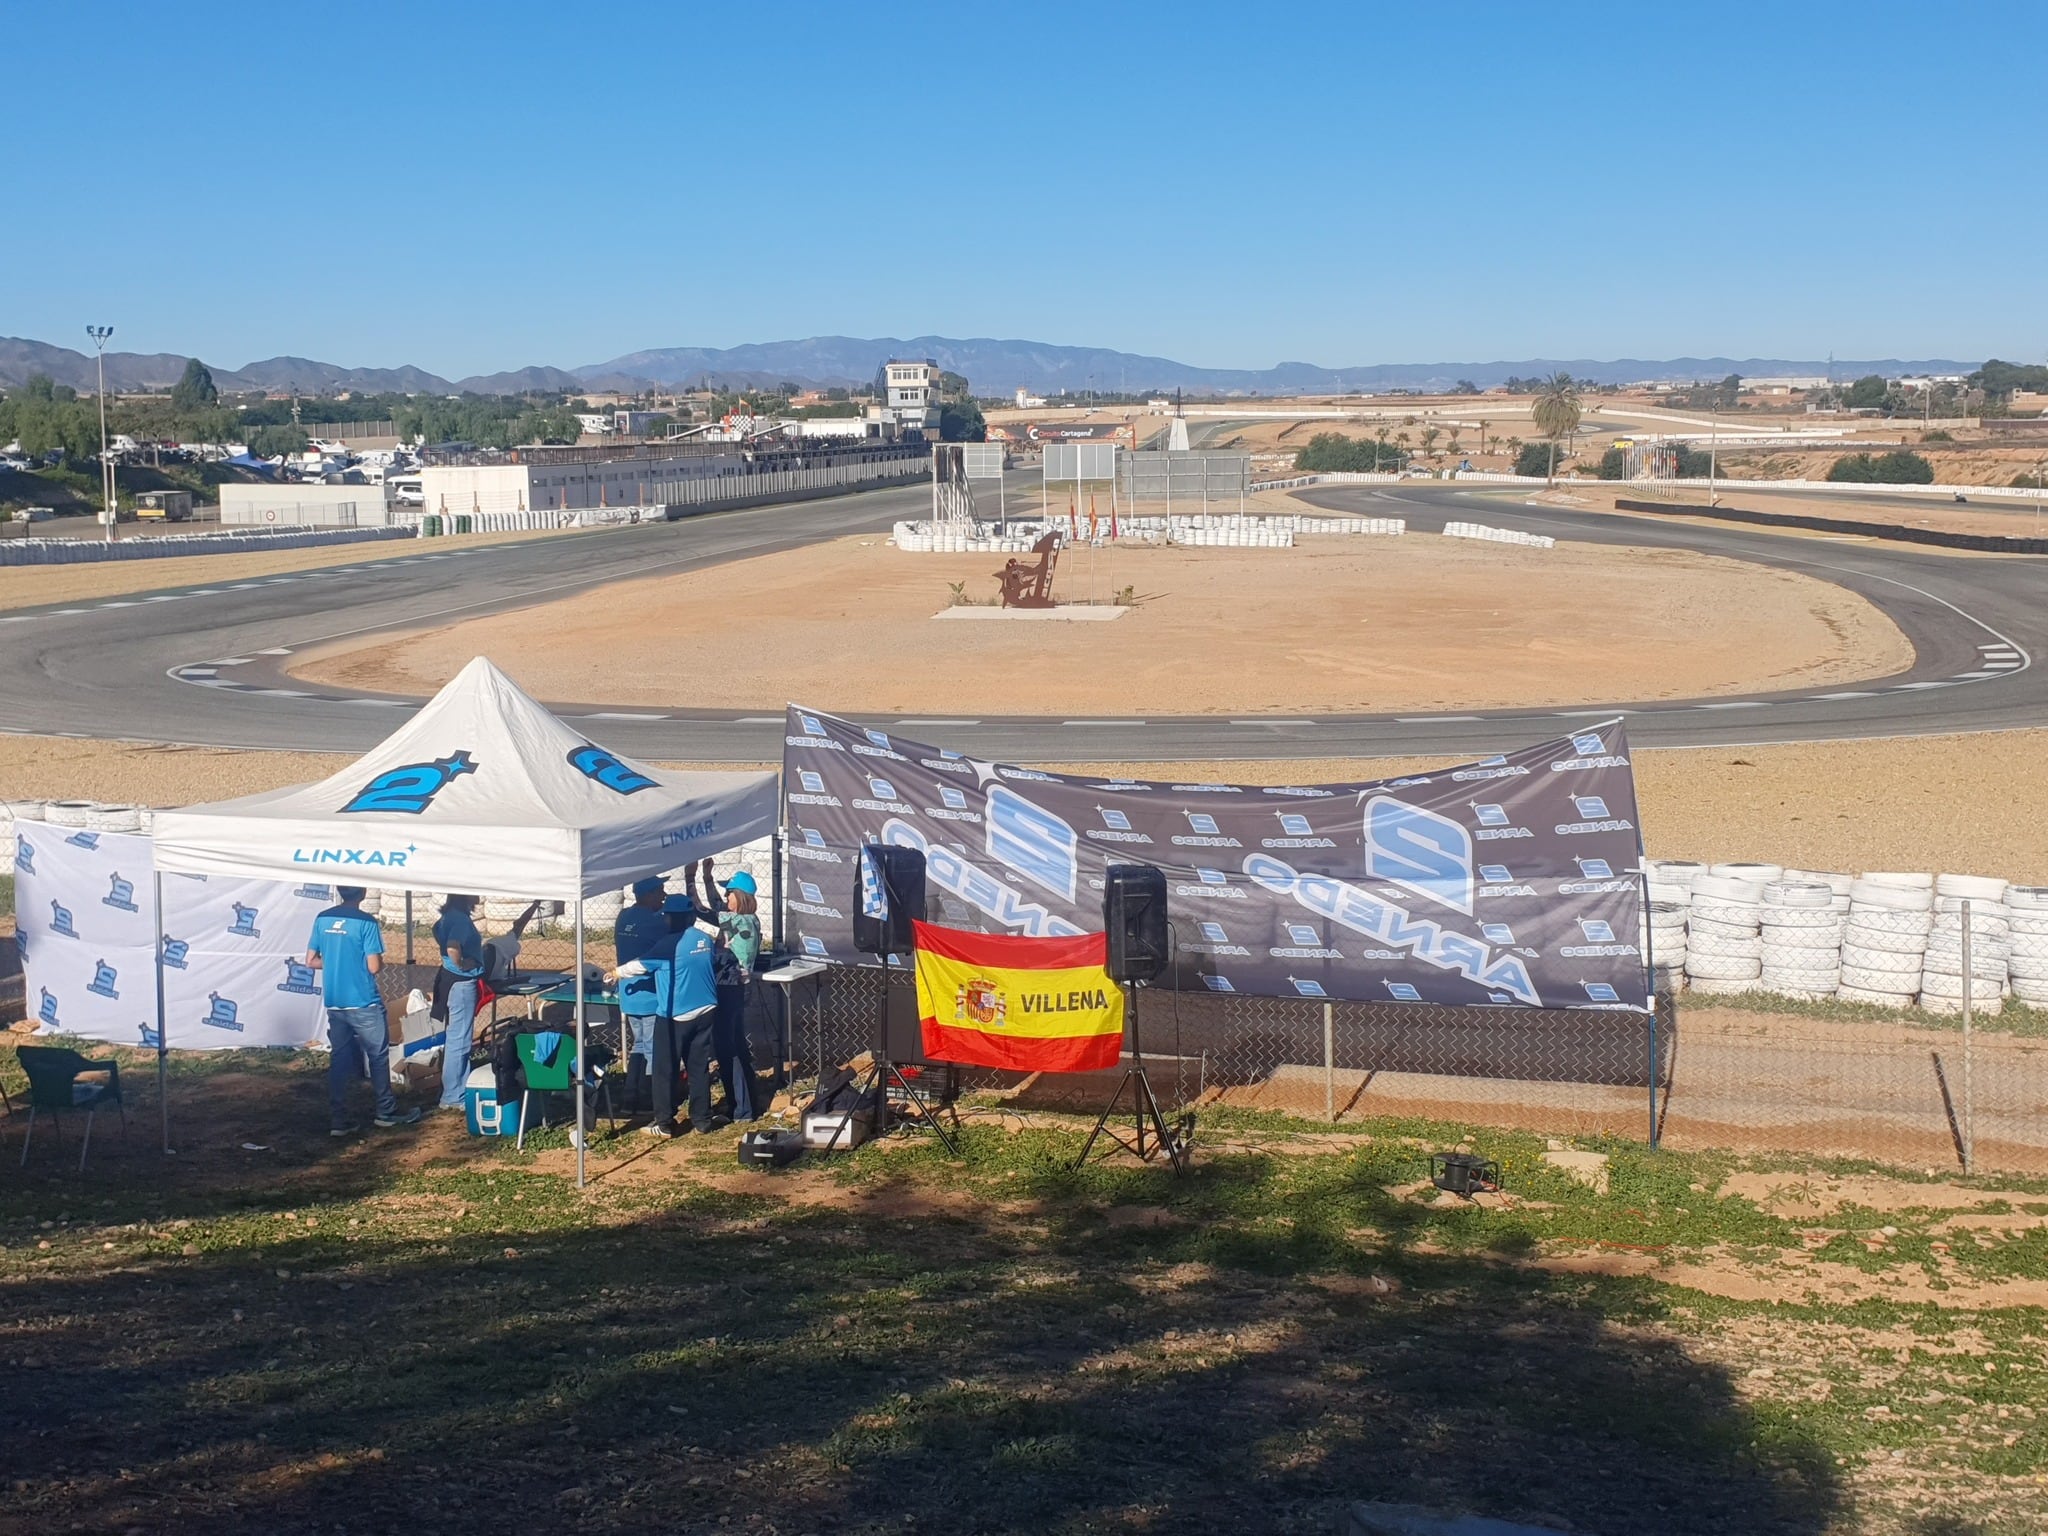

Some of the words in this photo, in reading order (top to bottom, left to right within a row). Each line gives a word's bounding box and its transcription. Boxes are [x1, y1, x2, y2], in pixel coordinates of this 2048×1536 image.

[1038, 430, 1061, 438] Circuito
[1060, 430, 1092, 438] Cartagena
[660, 819, 714, 849] LINXAR
[293, 848, 408, 867] LINXAR
[1021, 989, 1109, 1013] VILLENA
